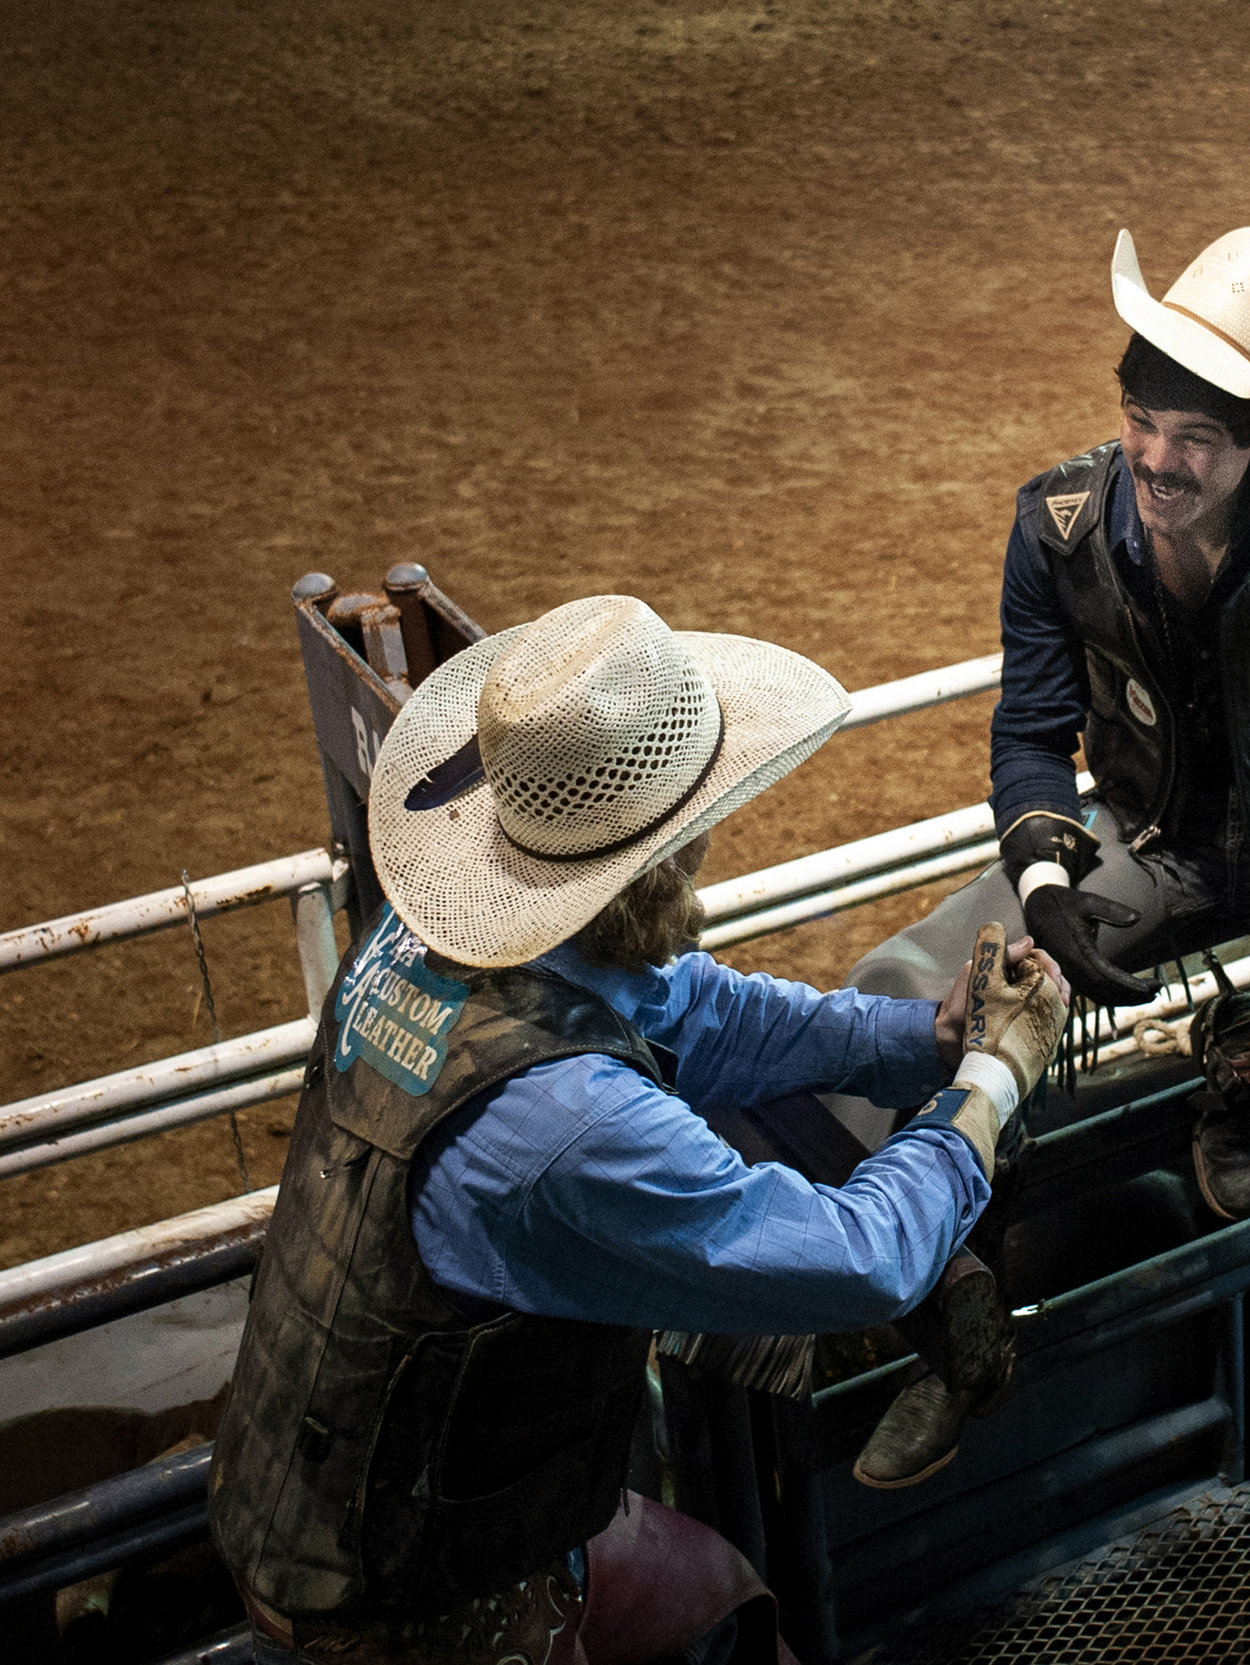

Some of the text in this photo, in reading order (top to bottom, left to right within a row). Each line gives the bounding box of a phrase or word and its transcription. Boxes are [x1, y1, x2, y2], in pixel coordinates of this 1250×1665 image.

[378, 967, 453, 1036] CUSTOM
[969, 941, 998, 1047] ESSARY
[352, 1001, 438, 1081] LEATHER
